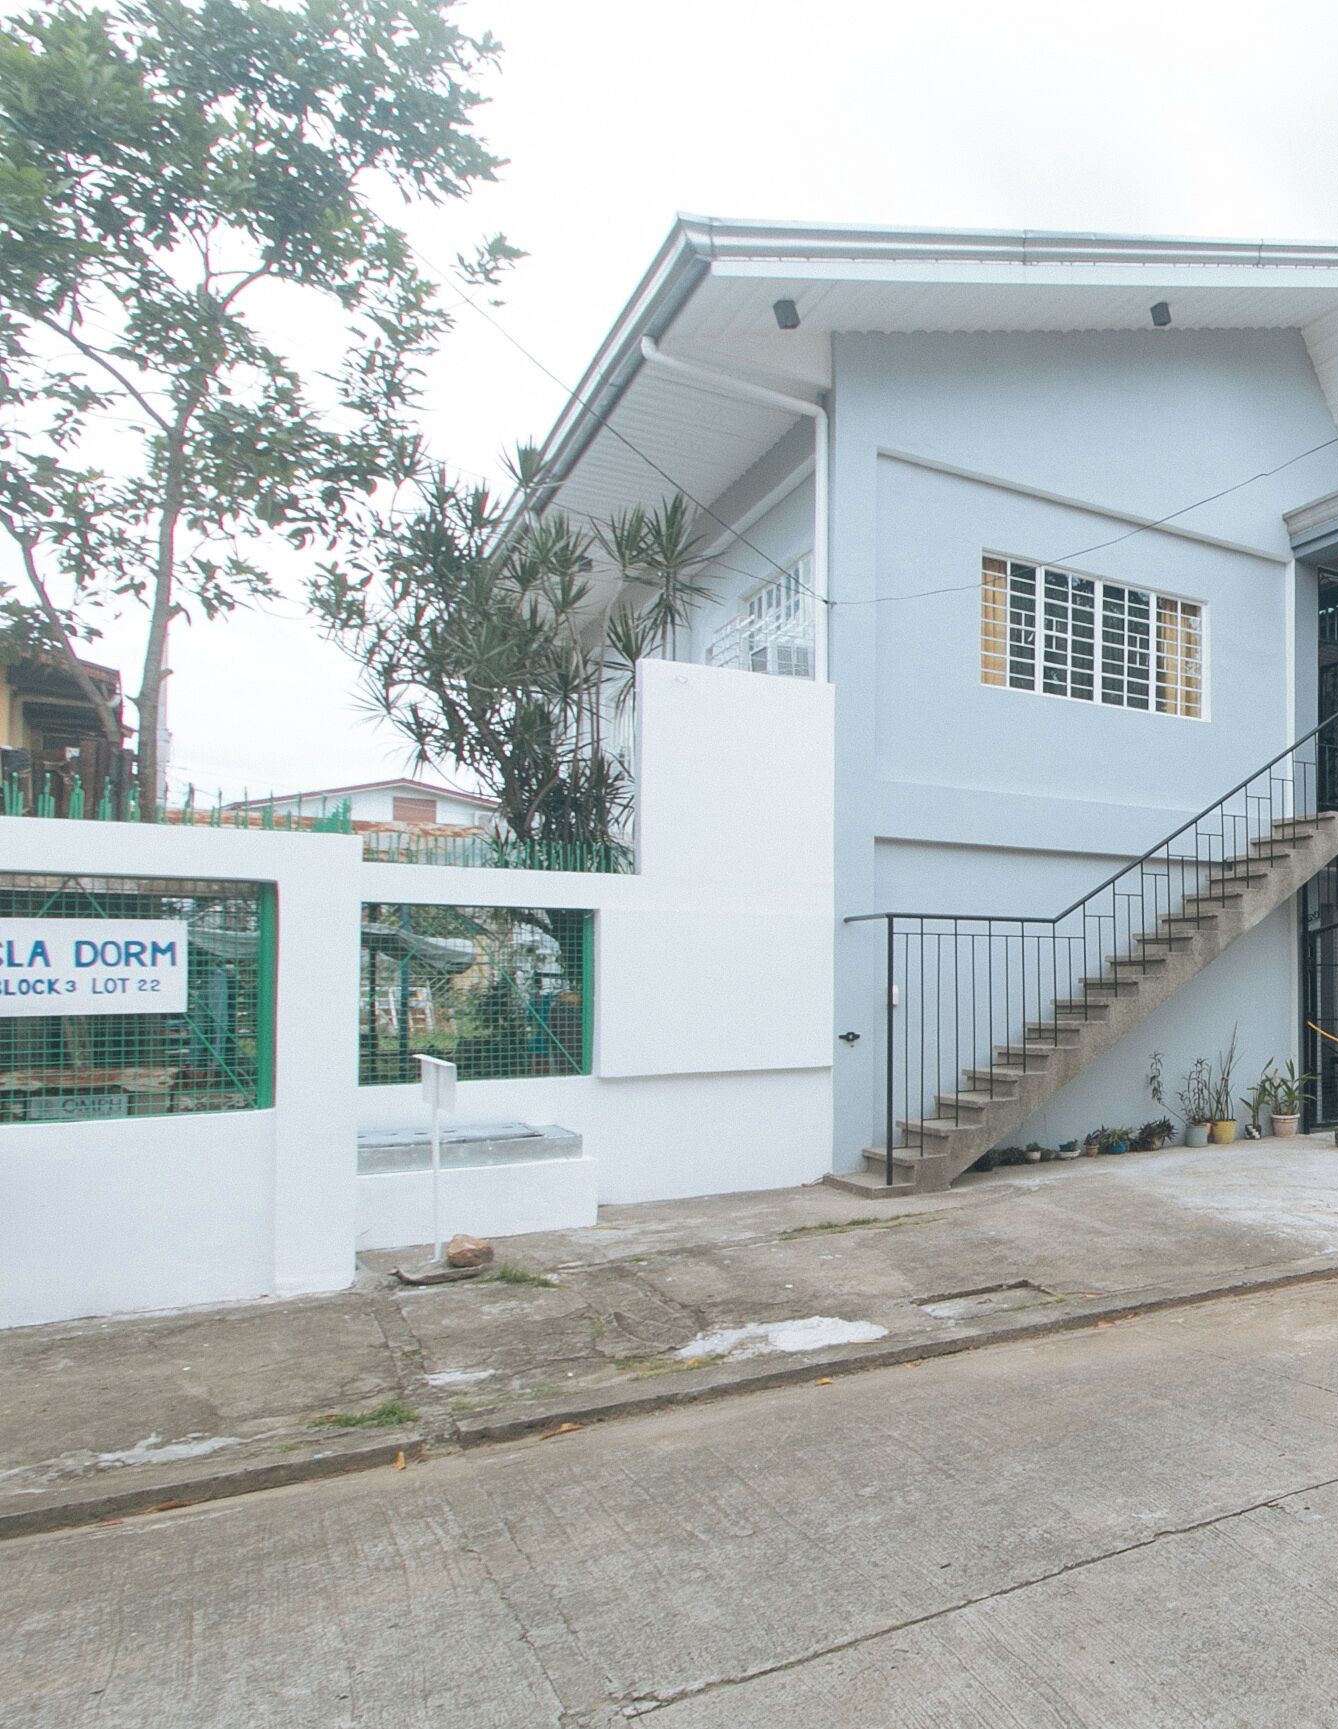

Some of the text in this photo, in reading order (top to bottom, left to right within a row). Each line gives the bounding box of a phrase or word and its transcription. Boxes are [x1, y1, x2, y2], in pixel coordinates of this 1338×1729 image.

[0, 940, 177, 968] LA DORM
[0, 977, 161, 996] LOCK 3 LOT 22
